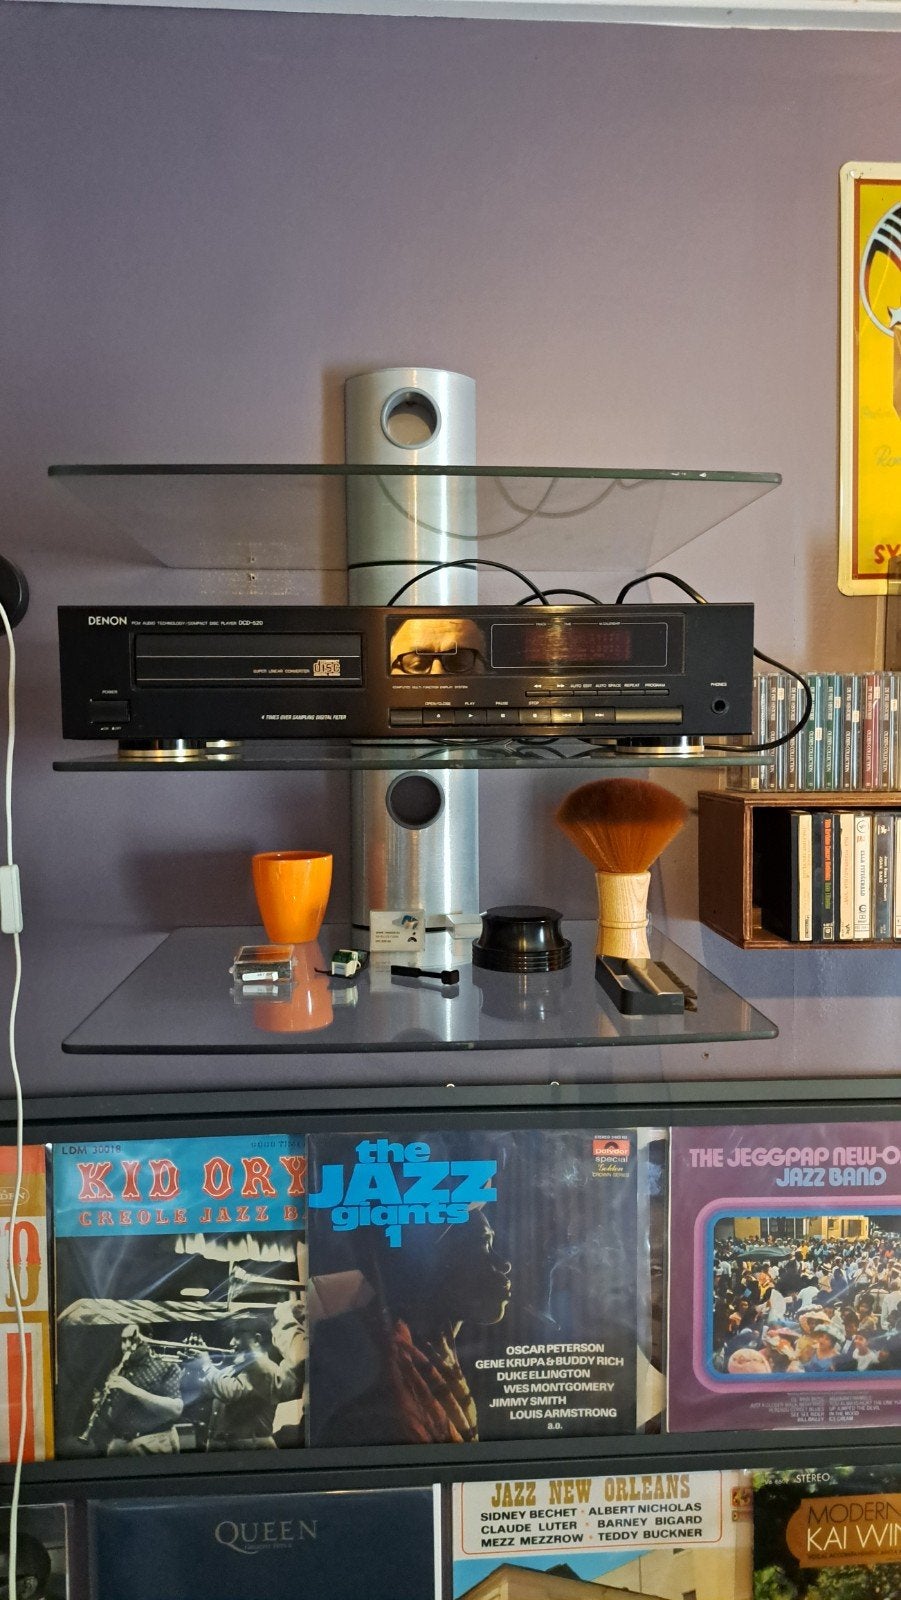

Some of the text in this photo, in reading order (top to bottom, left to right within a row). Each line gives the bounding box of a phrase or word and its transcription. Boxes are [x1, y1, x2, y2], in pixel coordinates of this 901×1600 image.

[88, 616, 127, 626] DENON
[62, 1145, 121, 1155] LDM 30018
[355, 1139, 431, 1163] the
[689, 1148, 724, 1168] THE
[727, 1146, 829, 1168] JEGGPAP
[77, 1156, 307, 1202] KID ORY
[309, 1160, 497, 1209] JAZZ
[776, 1166, 887, 1187] JAZZ BAND
[80, 1205, 307, 1228] CREOLE JAZZ B
[331, 1202, 470, 1231] giants
[385, 1224, 402, 1248] 1
[506, 1344, 604, 1355] OSCAR PETERSON
[475, 1356, 624, 1369] GENE KRUPA & BUDDY RICH
[497, 1369, 591, 1381] DUKE ELLINGTON
[503, 1382, 615, 1394] WES MONTGOMERY
[489, 1396, 567, 1408] JIMMY SMITH
[510, 1408, 617, 1420] LOUIS ARMSTRONG
[547, 1422, 563, 1430] a.o.
[796, 1473, 831, 1483] STEREO
[491, 1474, 691, 1507] JAZZ NEW ORLEANS
[480, 1502, 702, 1522] SIDNEY BECHET ALBERT NICHOLAS
[808, 1501, 901, 1524] MODERN
[480, 1515, 702, 1535] CLAUDE LUTER BARNEY BIGARD
[215, 1520, 318, 1554] QUEEN
[481, 1528, 702, 1548] MEZZ MEZZROW TEDDY BUCKNER
[807, 1525, 847, 1552] KAI
